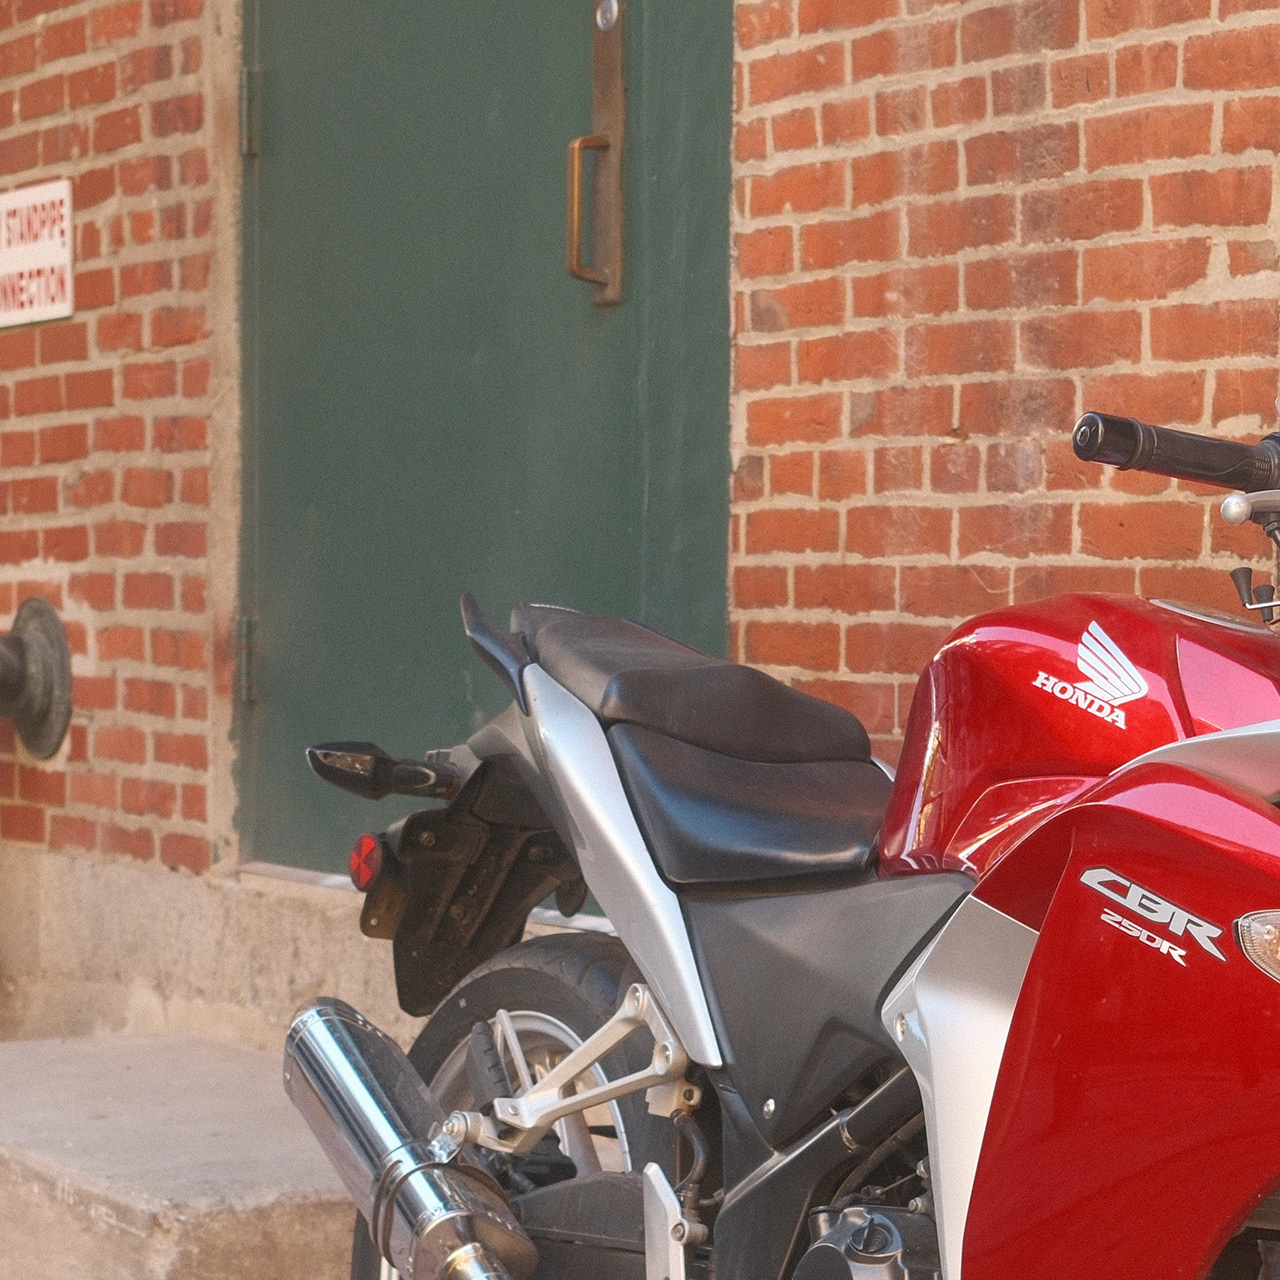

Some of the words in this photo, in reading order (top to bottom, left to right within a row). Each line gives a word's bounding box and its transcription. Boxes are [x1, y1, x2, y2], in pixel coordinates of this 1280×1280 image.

[6, 198, 65, 249] STANDPIPE
[1032, 671, 1127, 730] HONDA
[1080, 867, 1228, 963] CBR
[1100, 907, 1188, 968] 250R
